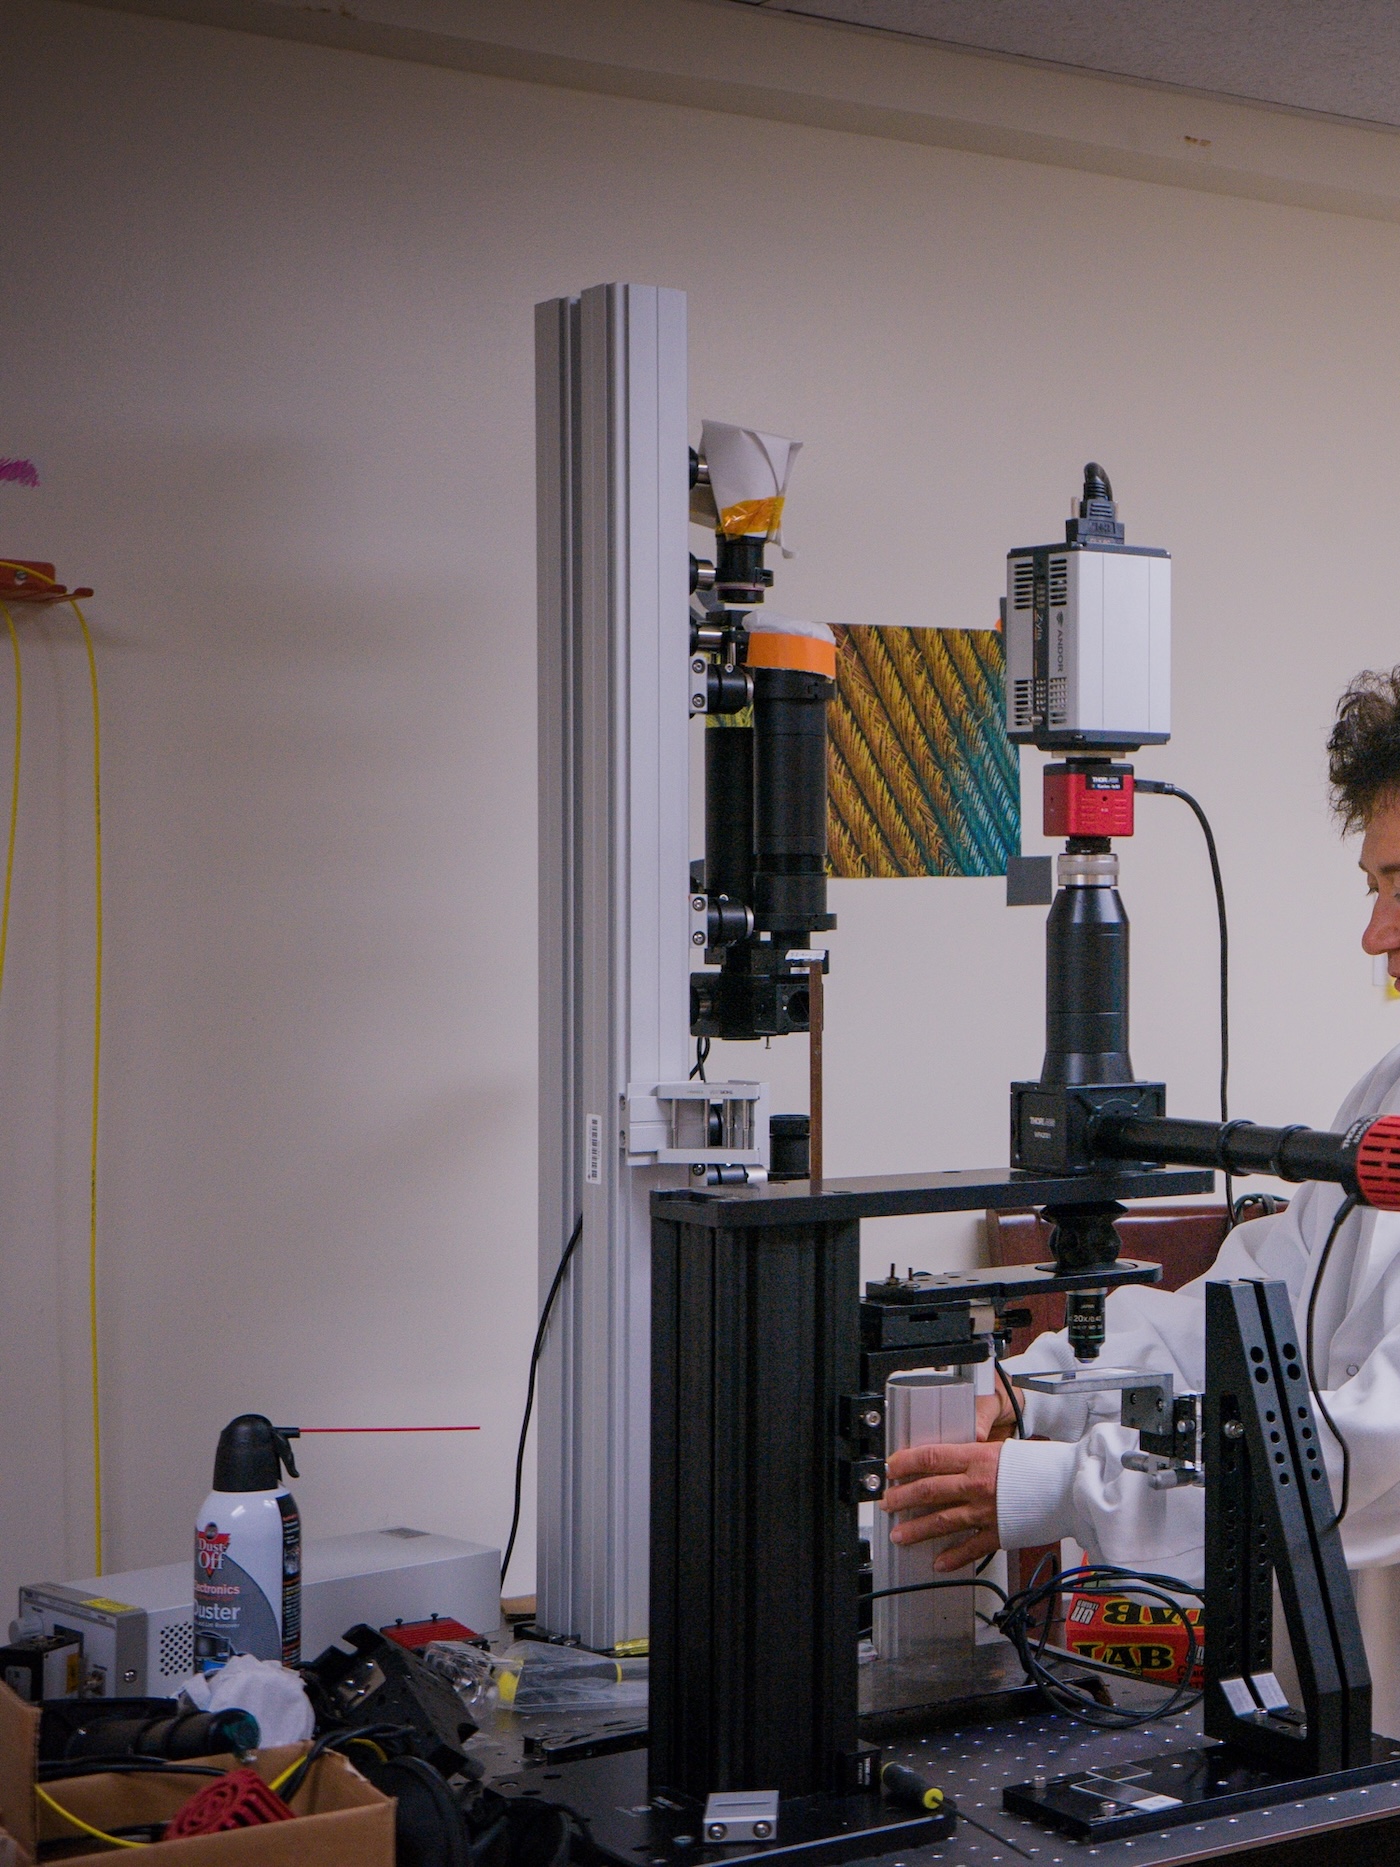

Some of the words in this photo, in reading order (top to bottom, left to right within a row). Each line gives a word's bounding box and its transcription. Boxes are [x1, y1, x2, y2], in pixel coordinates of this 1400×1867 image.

[1056, 629, 1064, 673] ANDOR
[198, 1538, 227, 1552] Dust-
[198, 1551, 225, 1570] Off
[194, 1581, 241, 1595] ectronics
[1072, 1641, 1175, 1671] LAB
